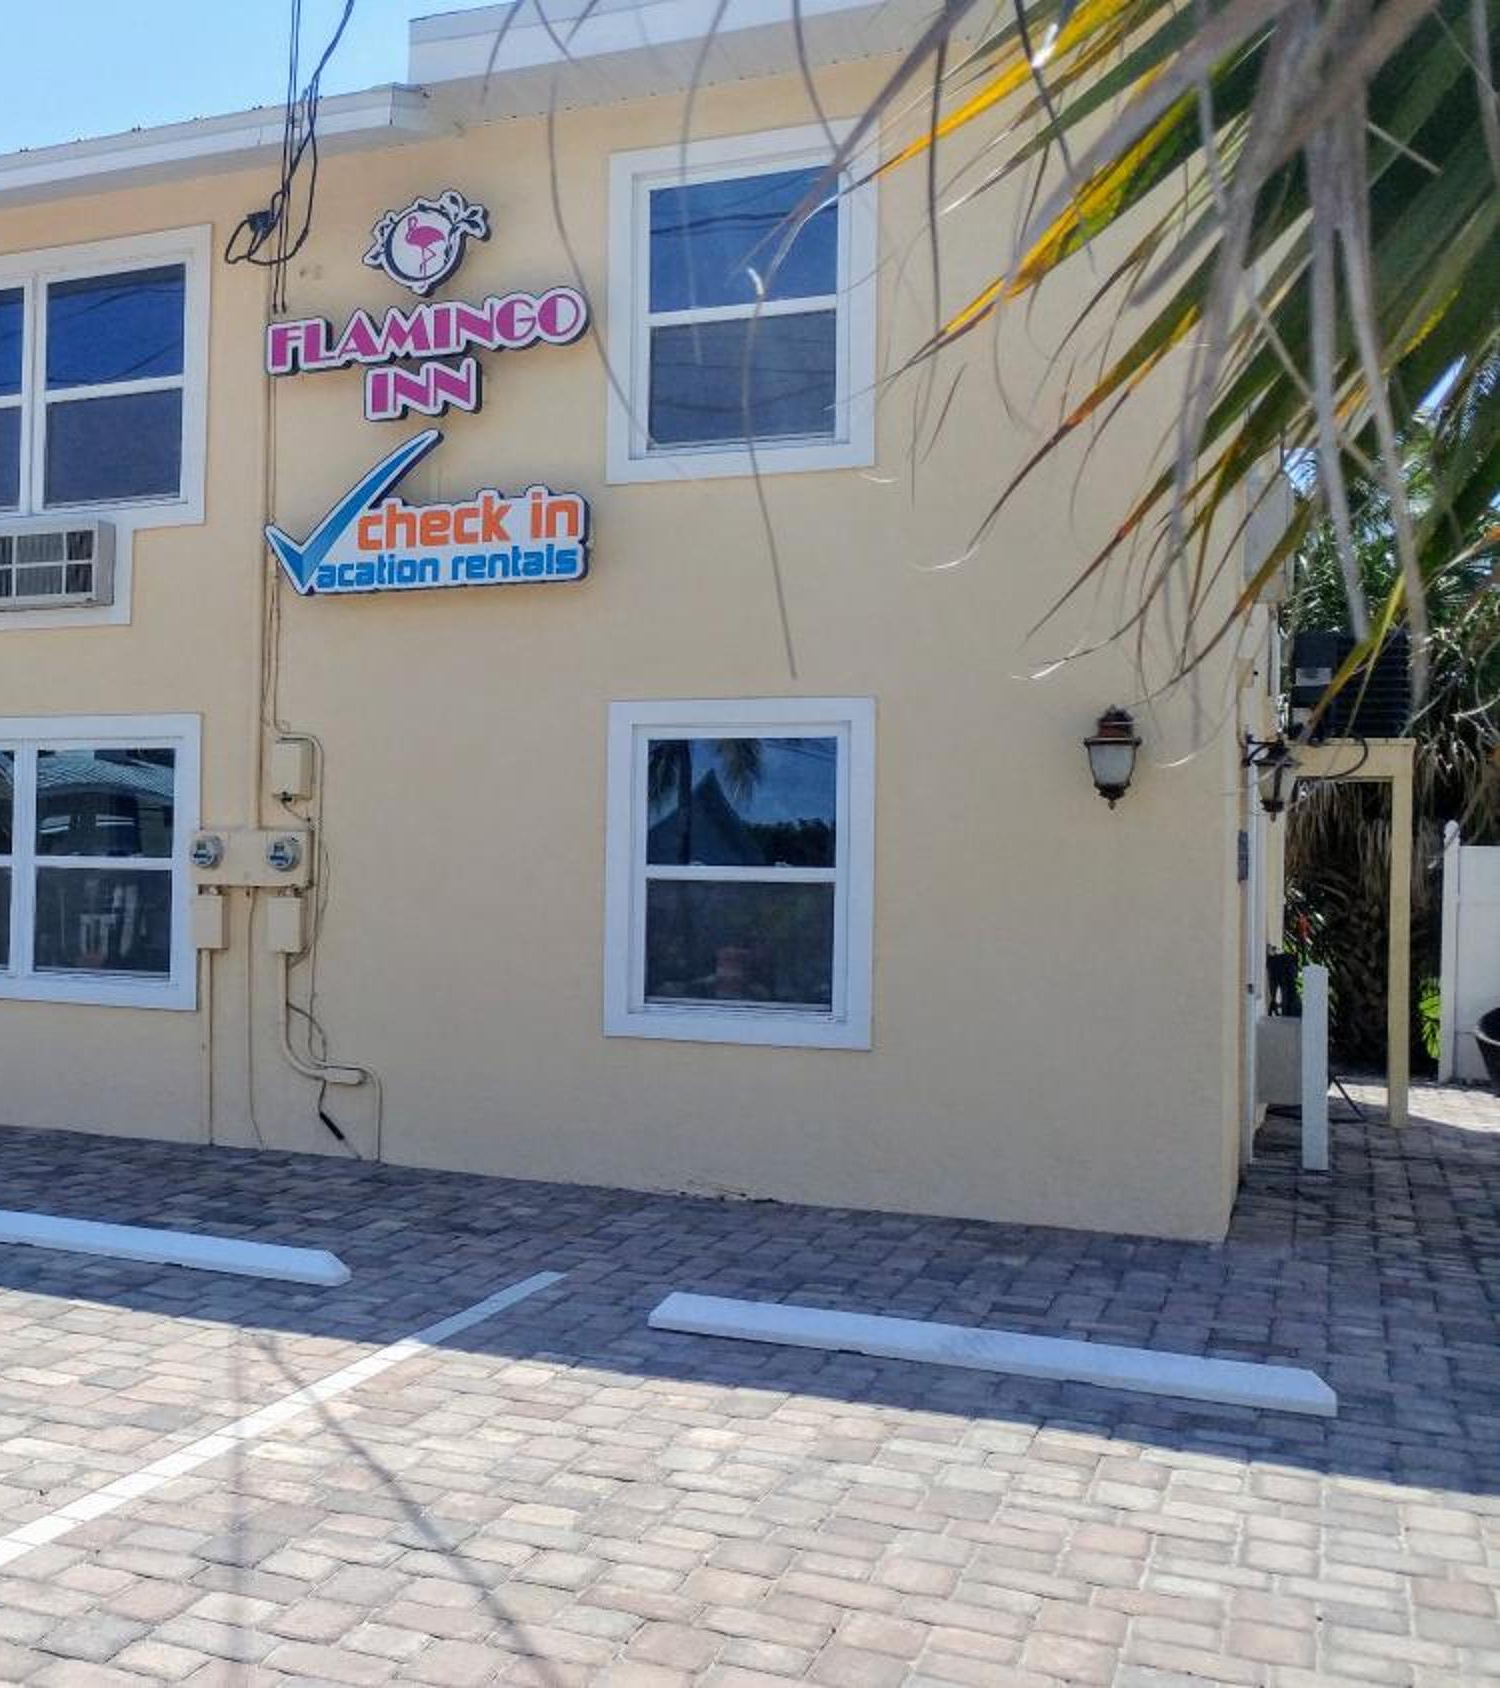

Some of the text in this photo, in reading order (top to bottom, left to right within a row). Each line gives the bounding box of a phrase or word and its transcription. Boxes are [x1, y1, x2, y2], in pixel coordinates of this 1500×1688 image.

[270, 293, 581, 368] FLAMINGO
[370, 363, 472, 414] INN
[357, 491, 579, 551] check in
[451, 543, 578, 581] rentals
